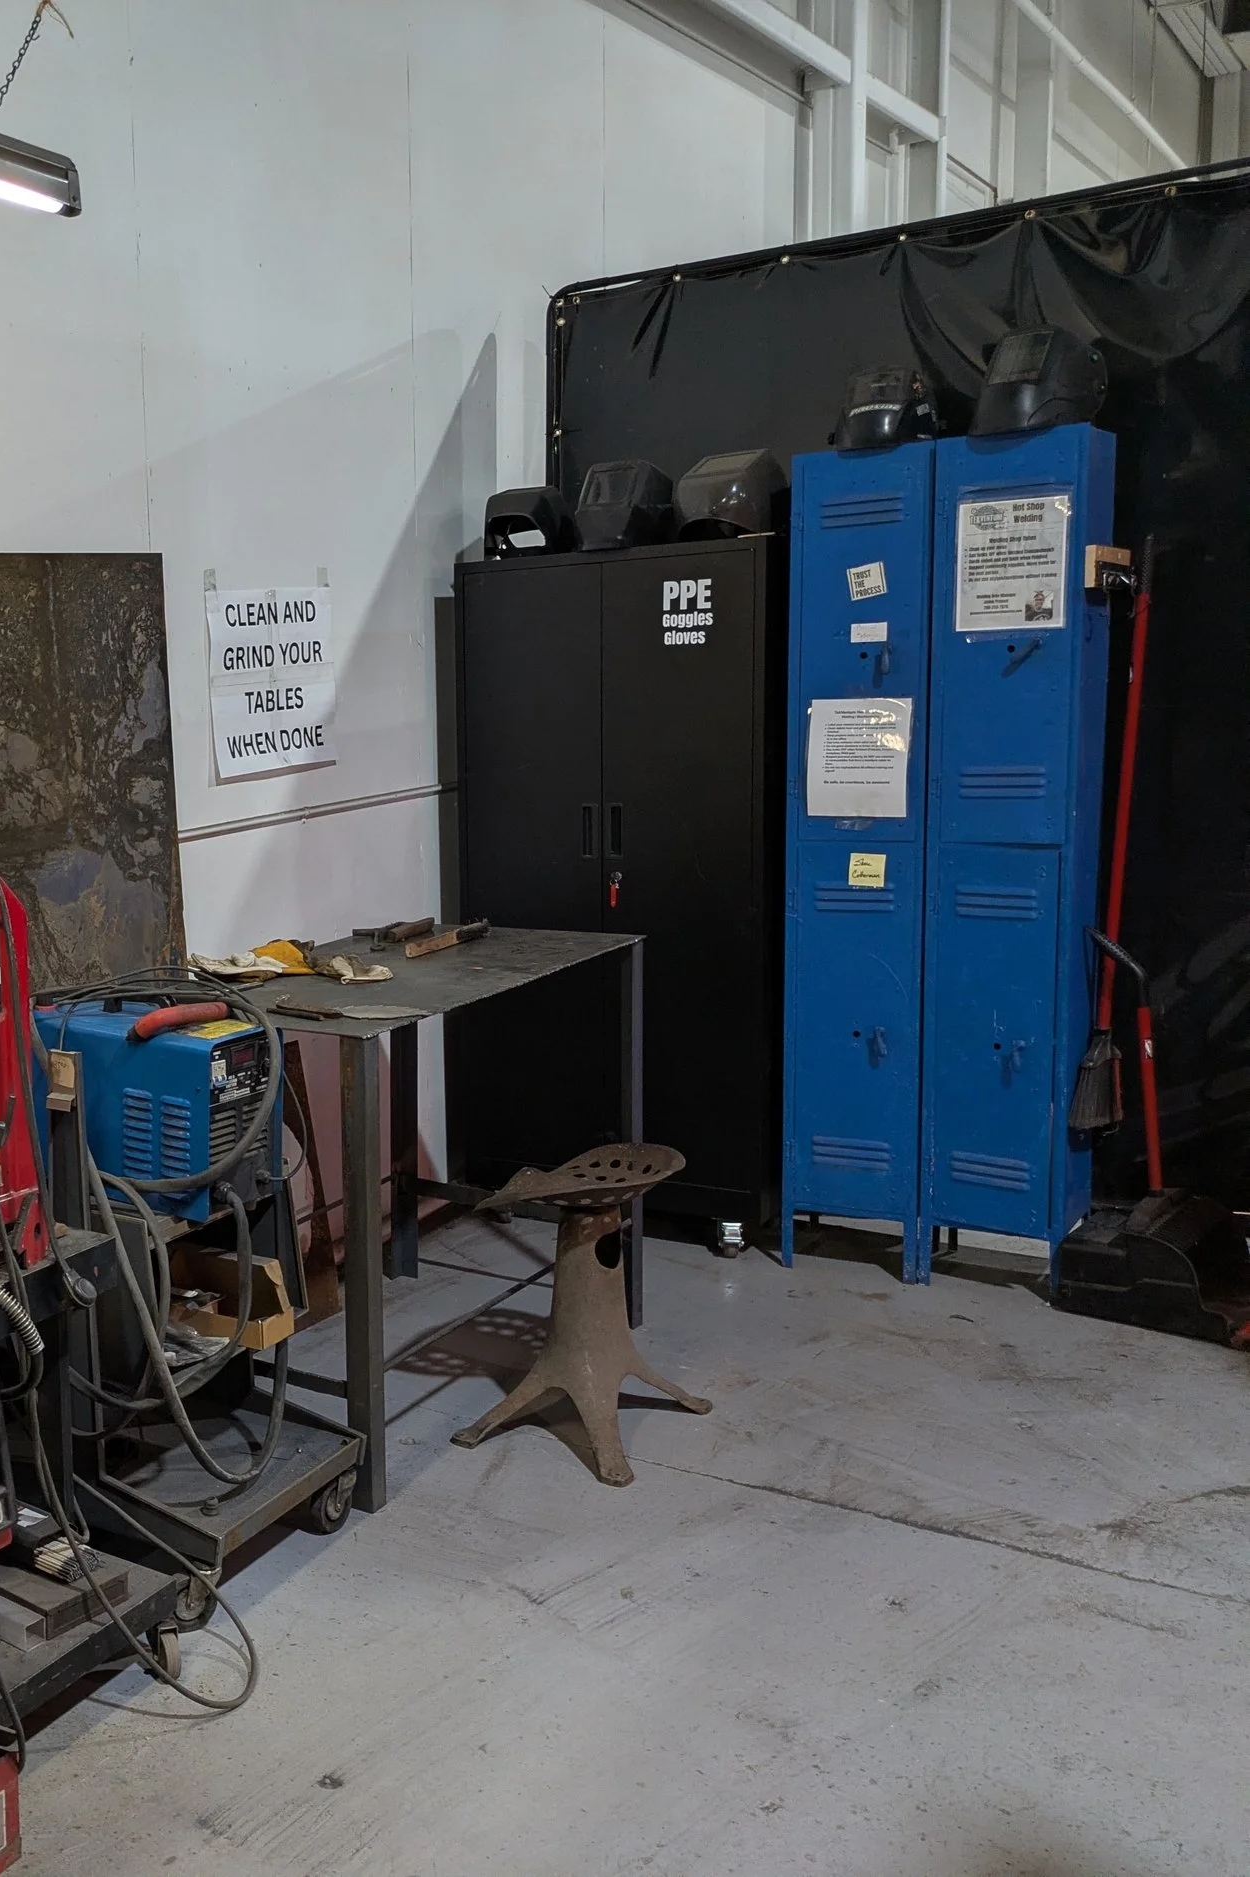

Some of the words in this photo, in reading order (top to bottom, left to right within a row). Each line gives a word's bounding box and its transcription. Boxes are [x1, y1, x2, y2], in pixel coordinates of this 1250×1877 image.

[1026, 502, 1044, 512] Shop
[1014, 514, 1043, 524] Welding
[852, 569, 871, 580] TRUST
[854, 580, 866, 589] THE
[855, 586, 882, 598] PROCESS
[662, 578, 712, 611] PPE
[225, 602, 278, 627] CLEAN
[283, 600, 316, 624] AND
[662, 611, 714, 628] Goggles
[664, 630, 706, 646] Gloves
[223, 644, 274, 671] GRIND
[279, 640, 323, 666] YOUR
[244, 686, 304, 714] TABLES
[226, 731, 278, 759] WHEN
[280, 725, 324, 751] DONE
